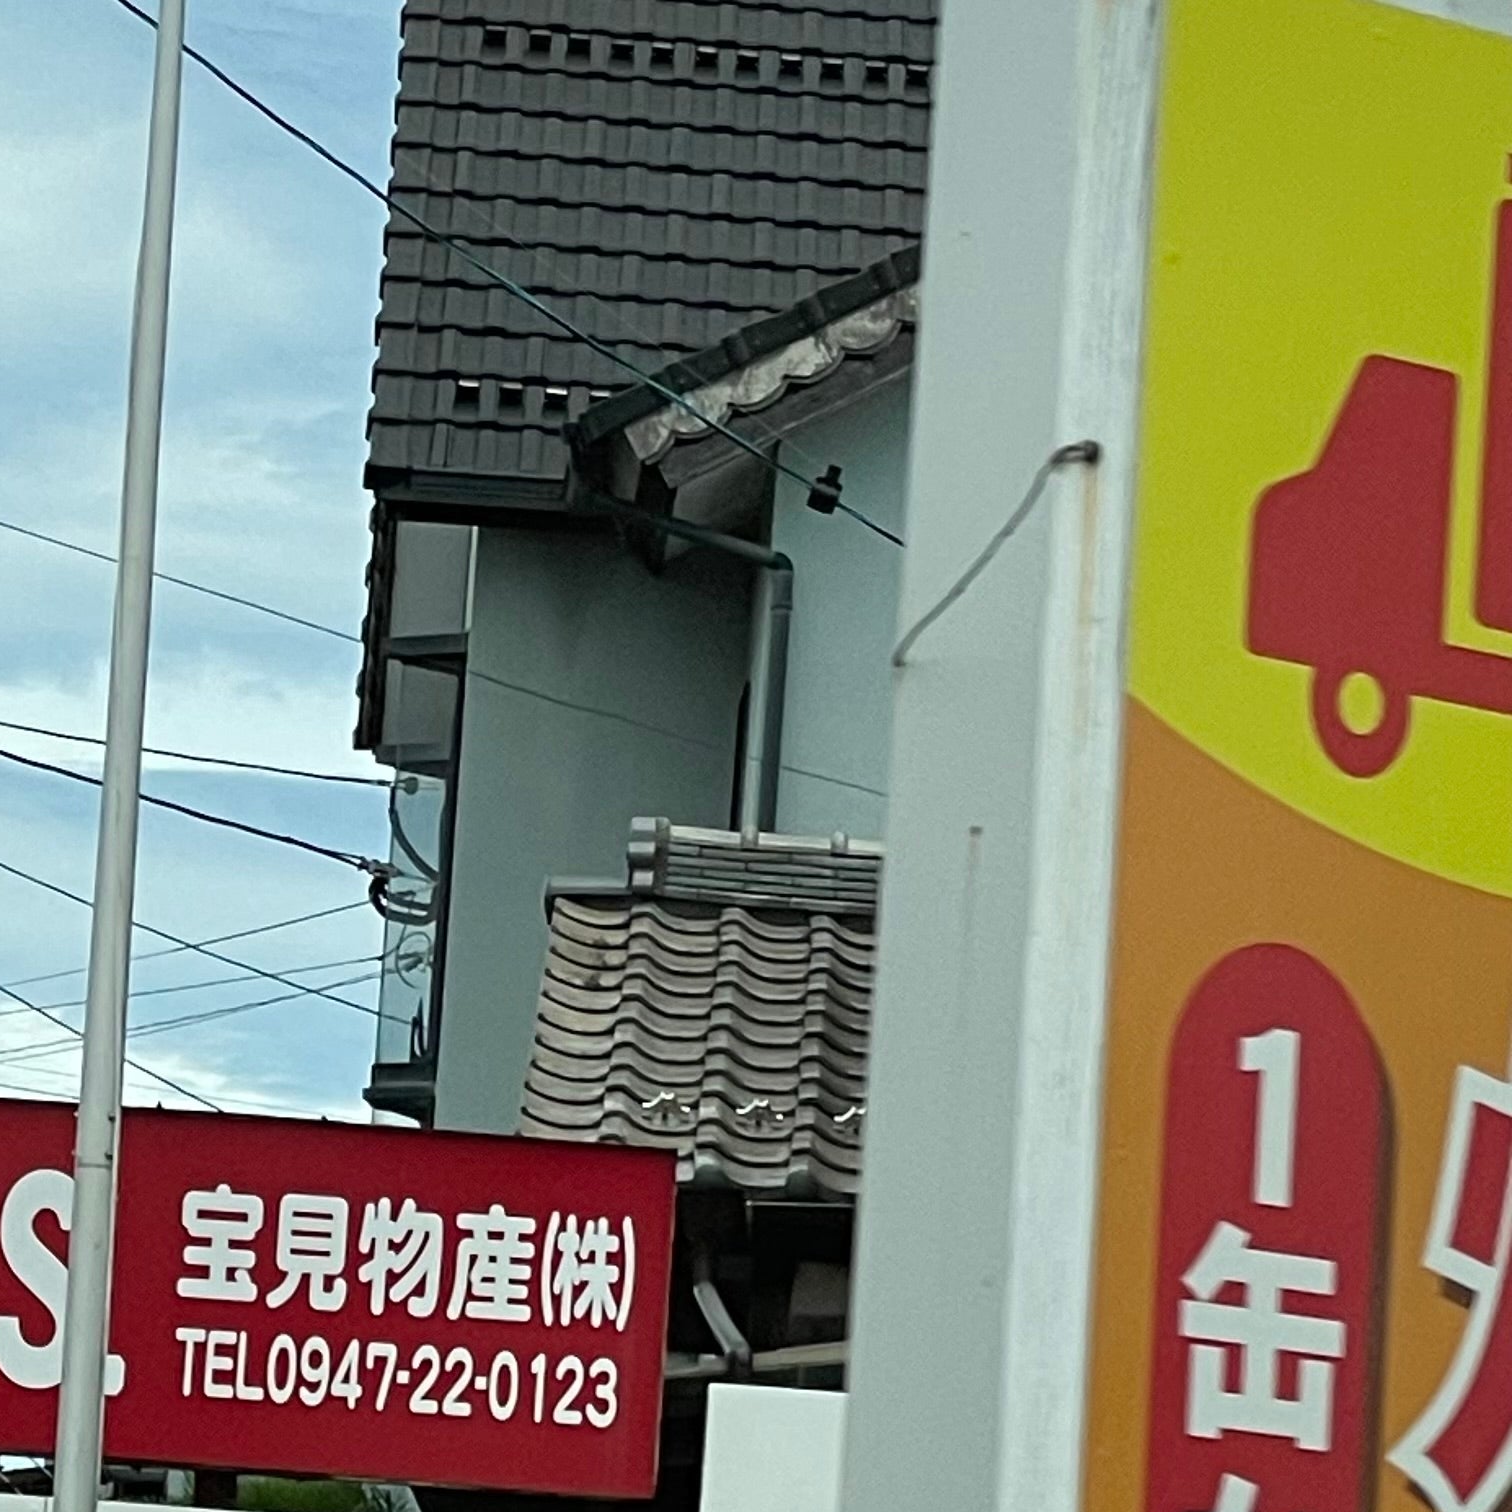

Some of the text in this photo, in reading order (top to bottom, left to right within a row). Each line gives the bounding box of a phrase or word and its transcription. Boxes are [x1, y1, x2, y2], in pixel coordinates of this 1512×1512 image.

[175, 1183, 636, 1332] 宝見物産(株)
[175, 1326, 619, 1429] TEL0947-22-0123
